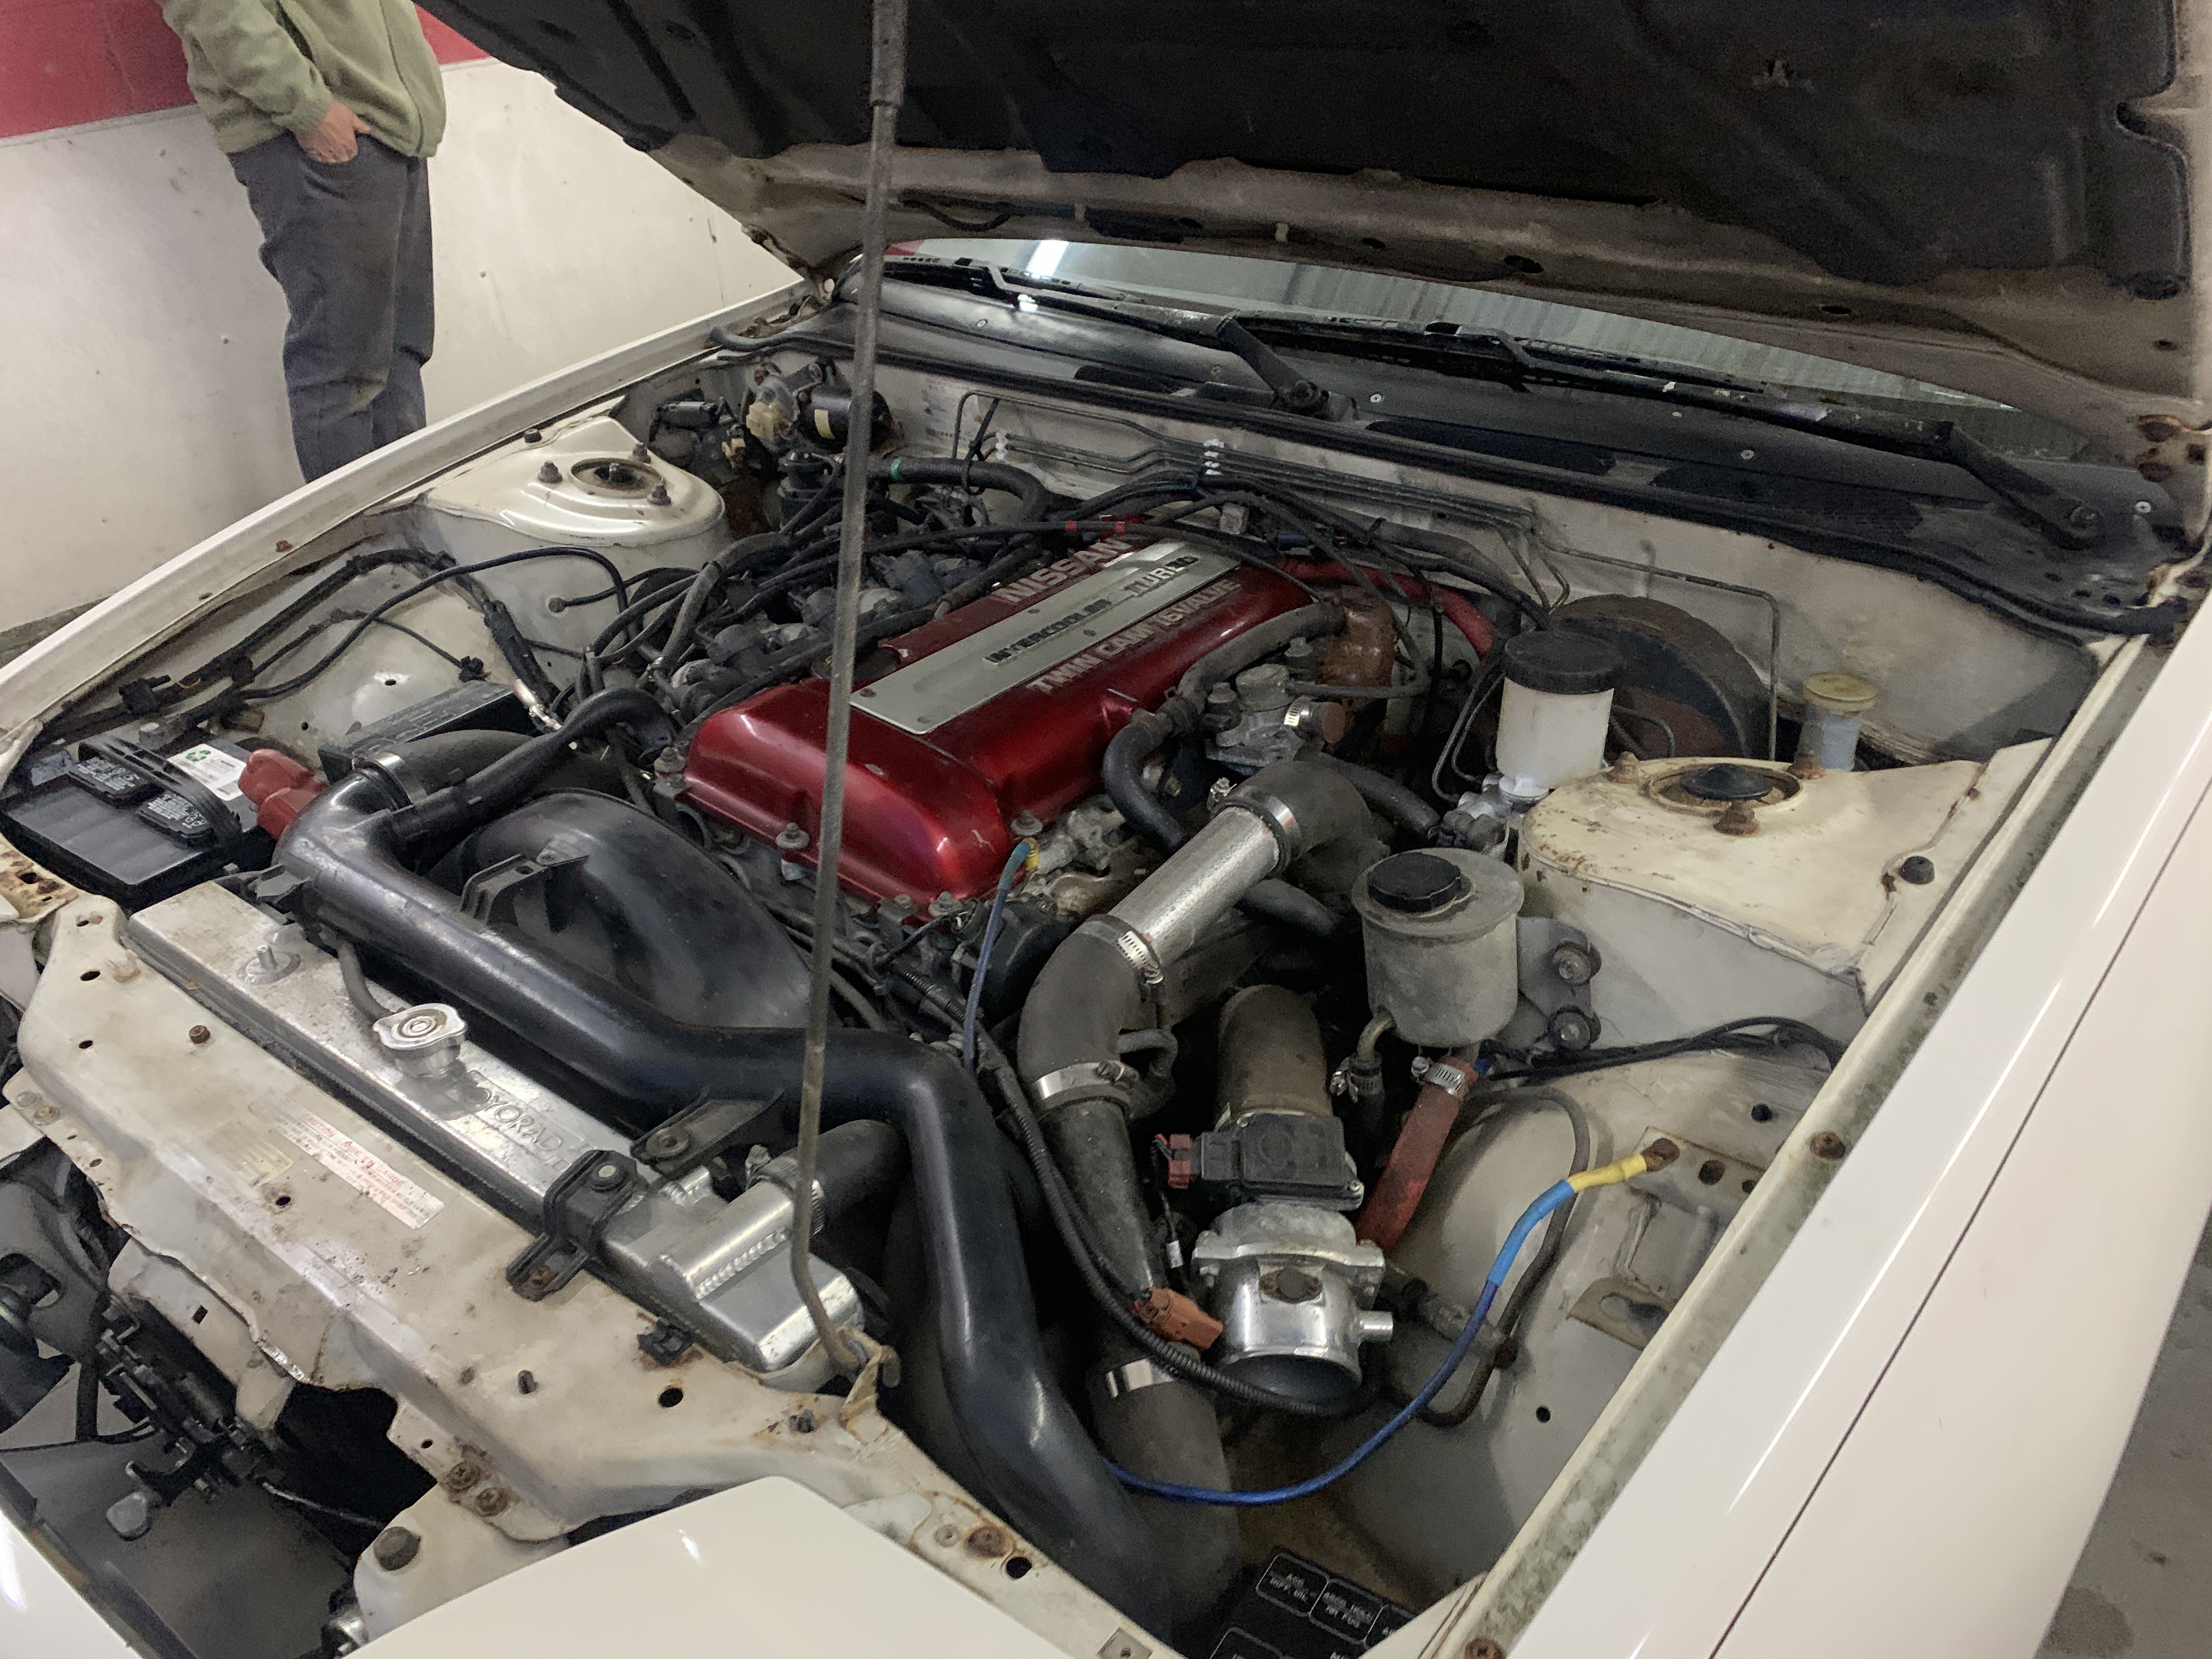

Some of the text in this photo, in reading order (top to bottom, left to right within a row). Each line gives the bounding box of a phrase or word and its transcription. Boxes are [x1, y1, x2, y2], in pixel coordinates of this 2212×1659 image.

[994, 537, 1132, 603] NISSAN
[984, 555, 1199, 663] INTERCOOLER TURBO
[1026, 653, 1104, 691] TWIN
[1096, 620, 1154, 657] CAM
[302, 1113, 336, 1138] CAUTION
[362, 1155, 376, 1168] EN
[375, 1165, 408, 1188] GARDE
